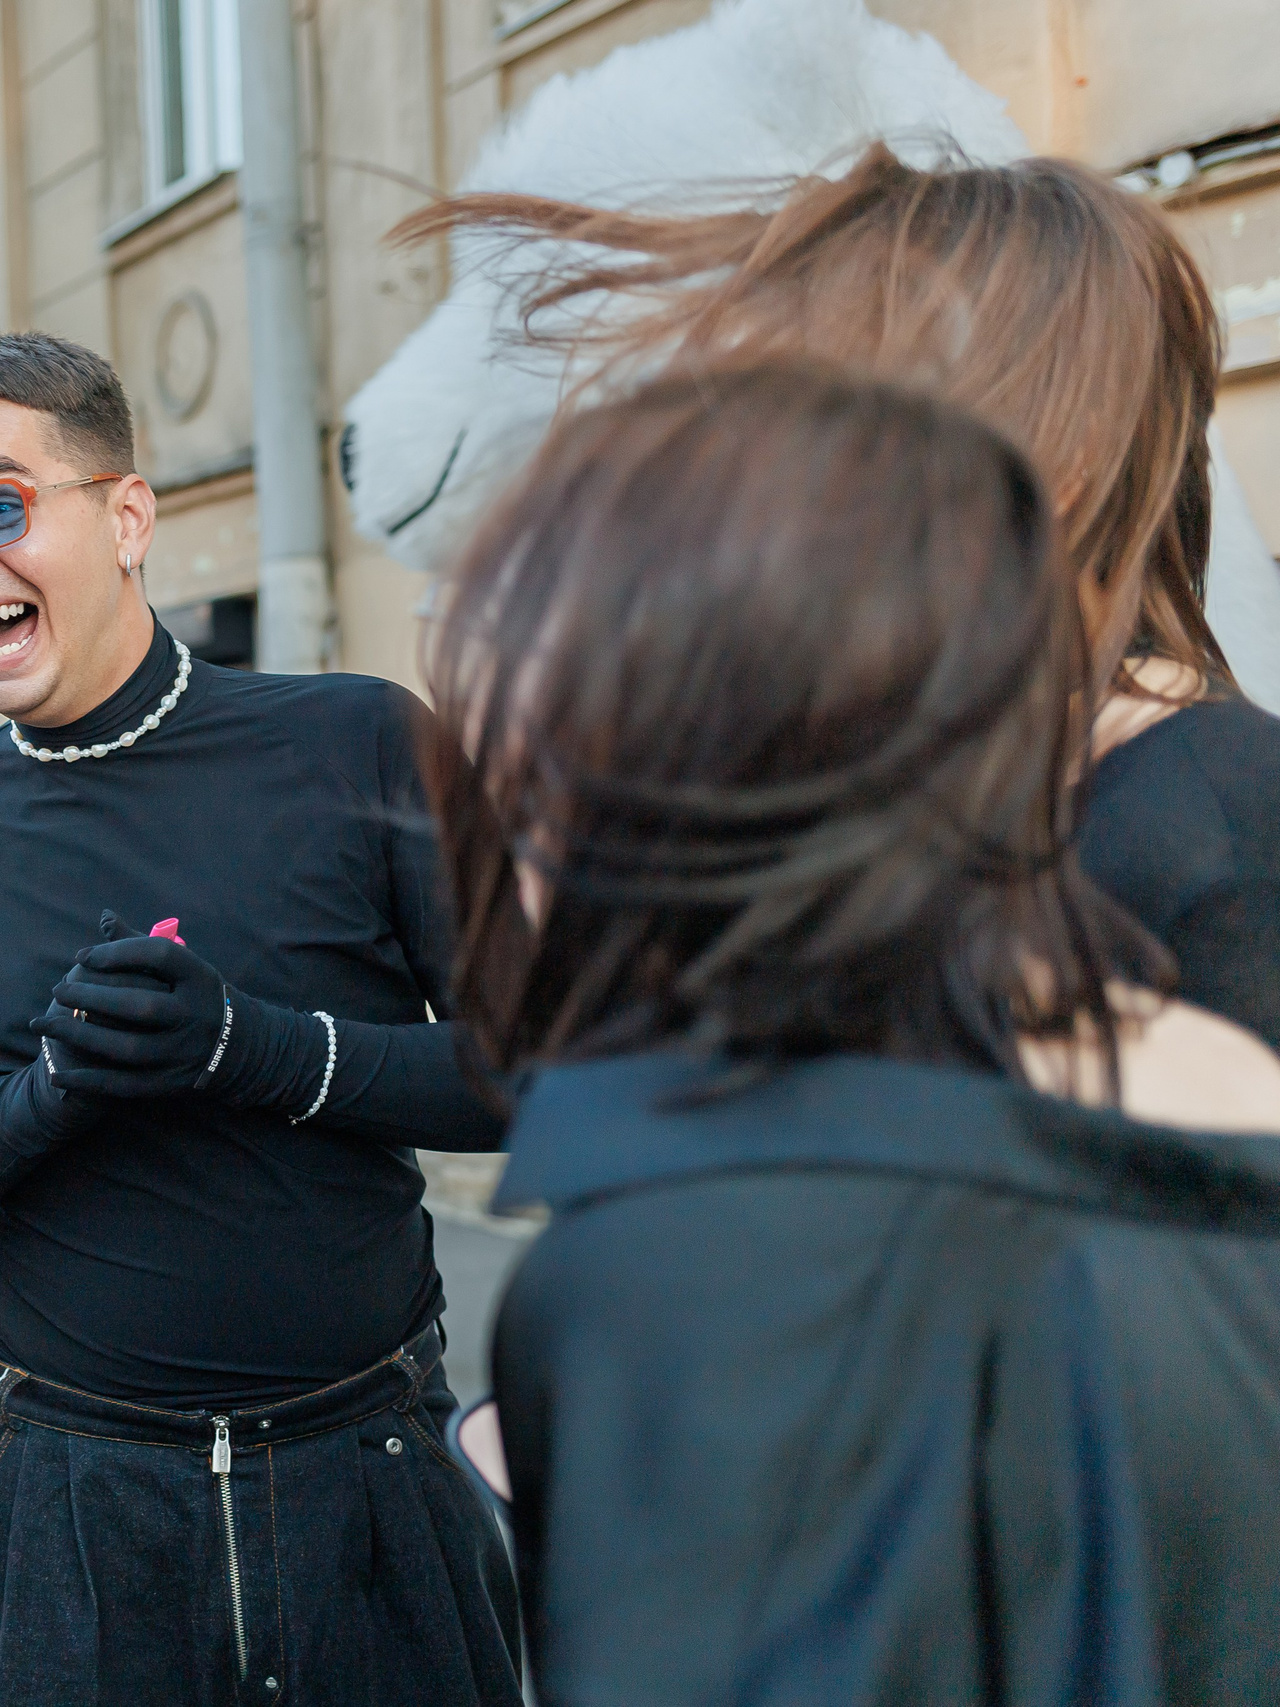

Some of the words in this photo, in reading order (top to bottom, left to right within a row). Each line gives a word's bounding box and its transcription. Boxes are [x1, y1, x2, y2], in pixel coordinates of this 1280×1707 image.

[225, 1005, 234, 1025] NOT
[221, 1025, 231, 1041] I'M
[207, 1041, 228, 1073] SORRY,
